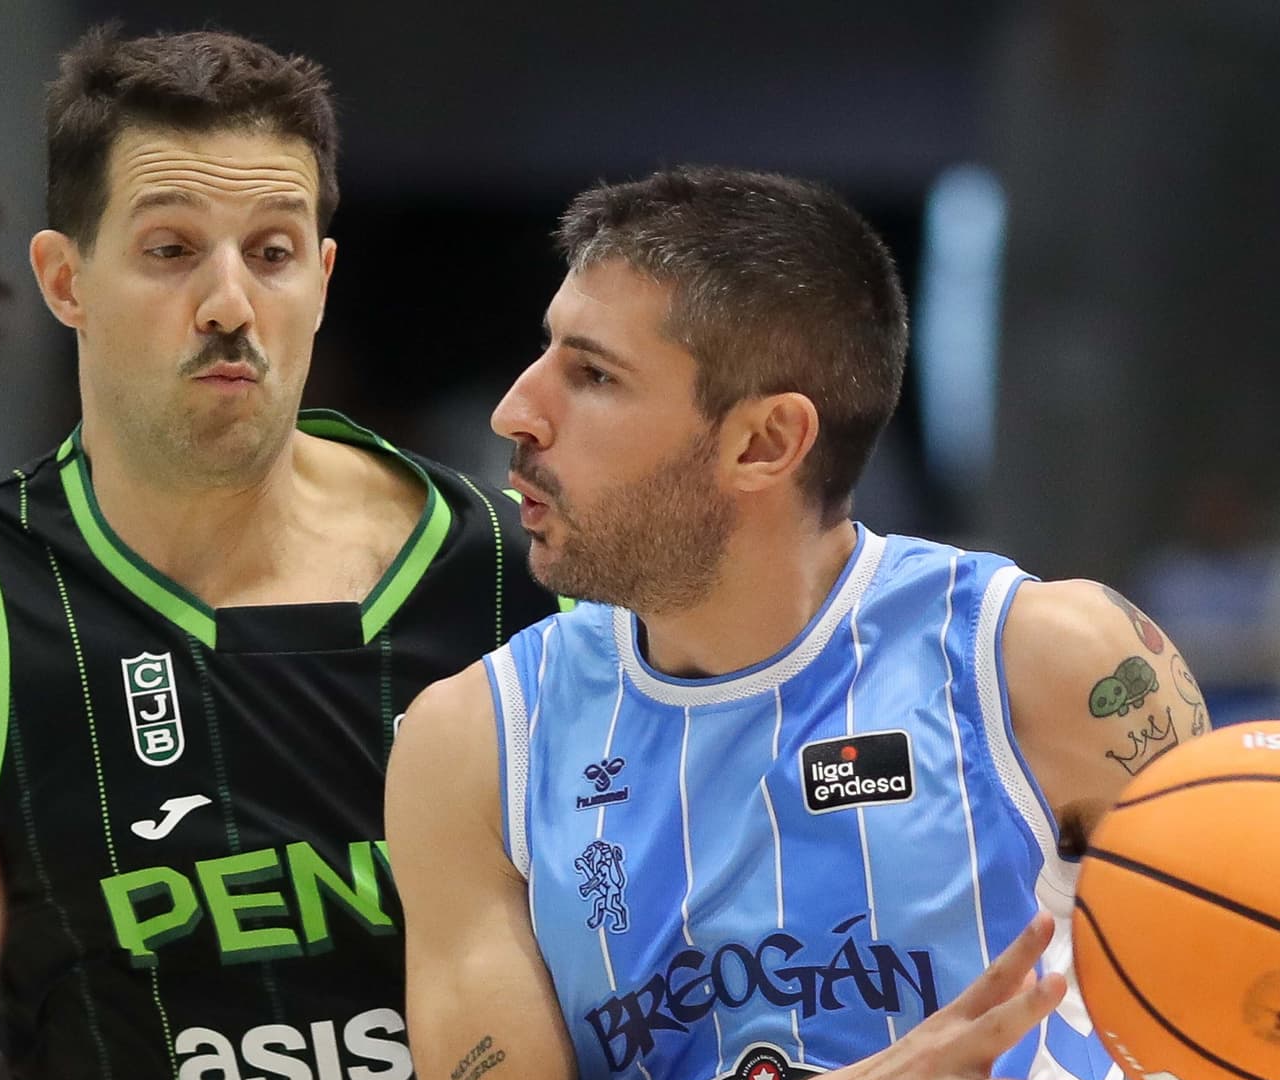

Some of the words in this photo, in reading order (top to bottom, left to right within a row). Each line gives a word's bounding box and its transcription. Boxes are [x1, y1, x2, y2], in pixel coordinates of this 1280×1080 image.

[134, 662, 175, 754] CJB
[812, 761, 854, 782] liga
[814, 776, 906, 801] endesa
[100, 840, 402, 967] PEN
[585, 914, 939, 1072] BREOGÁN
